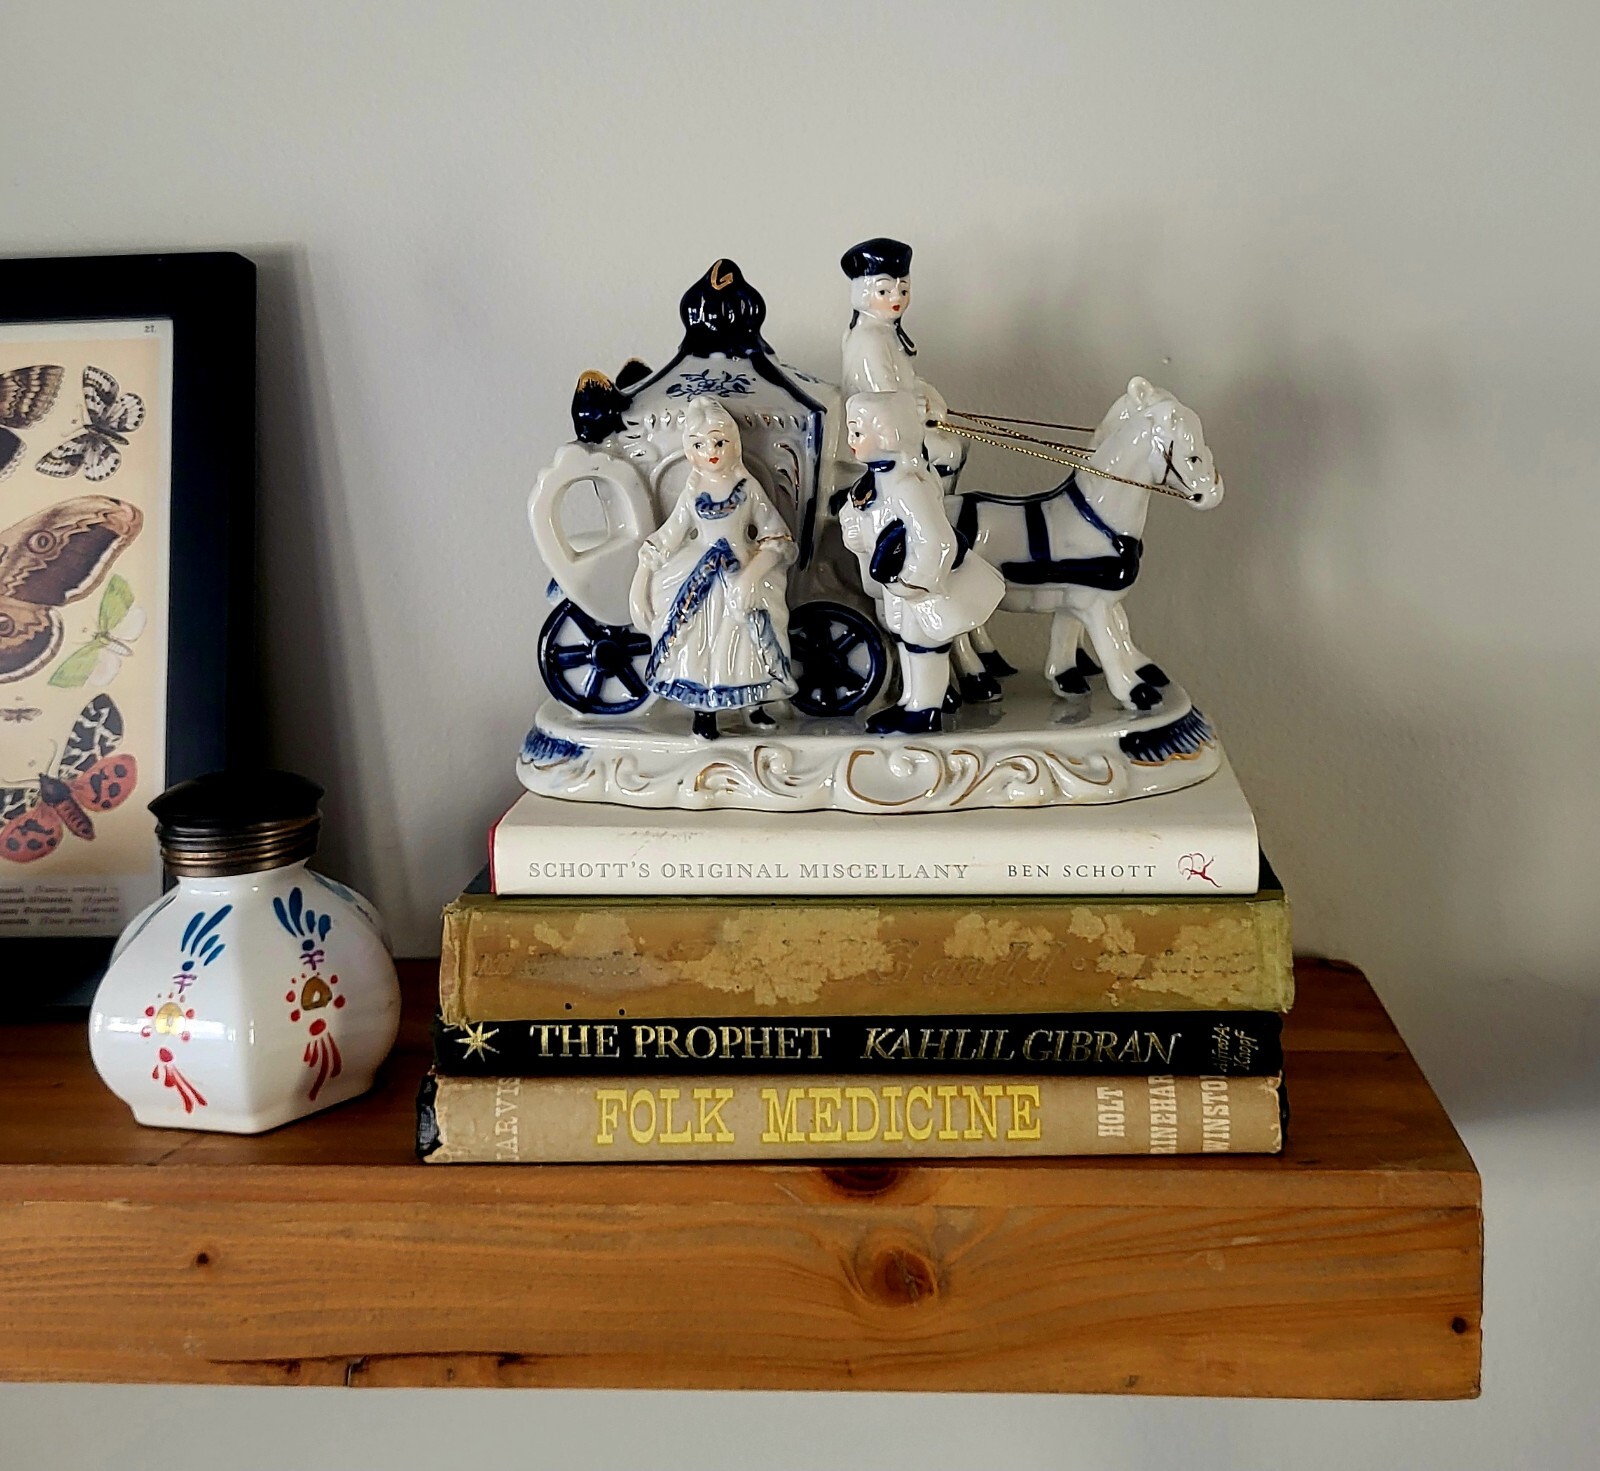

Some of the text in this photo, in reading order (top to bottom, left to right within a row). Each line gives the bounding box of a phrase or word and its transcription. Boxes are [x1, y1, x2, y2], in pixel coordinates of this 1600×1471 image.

[529, 862, 1157, 879] SCHOTT'S ORIGINAL MISCELLANY BEN SCHOTT
[529, 1024, 1183, 1064] THE PROPHET KAHLIL GIBRAN
[1233, 1029, 1259, 1071] Knopf
[495, 1077, 521, 1161] JARVIS
[595, 1085, 1042, 1145] FOLK MEDICINE
[1096, 1086, 1126, 1137] HOLT
[1200, 1075, 1231, 1151] WINSTO
